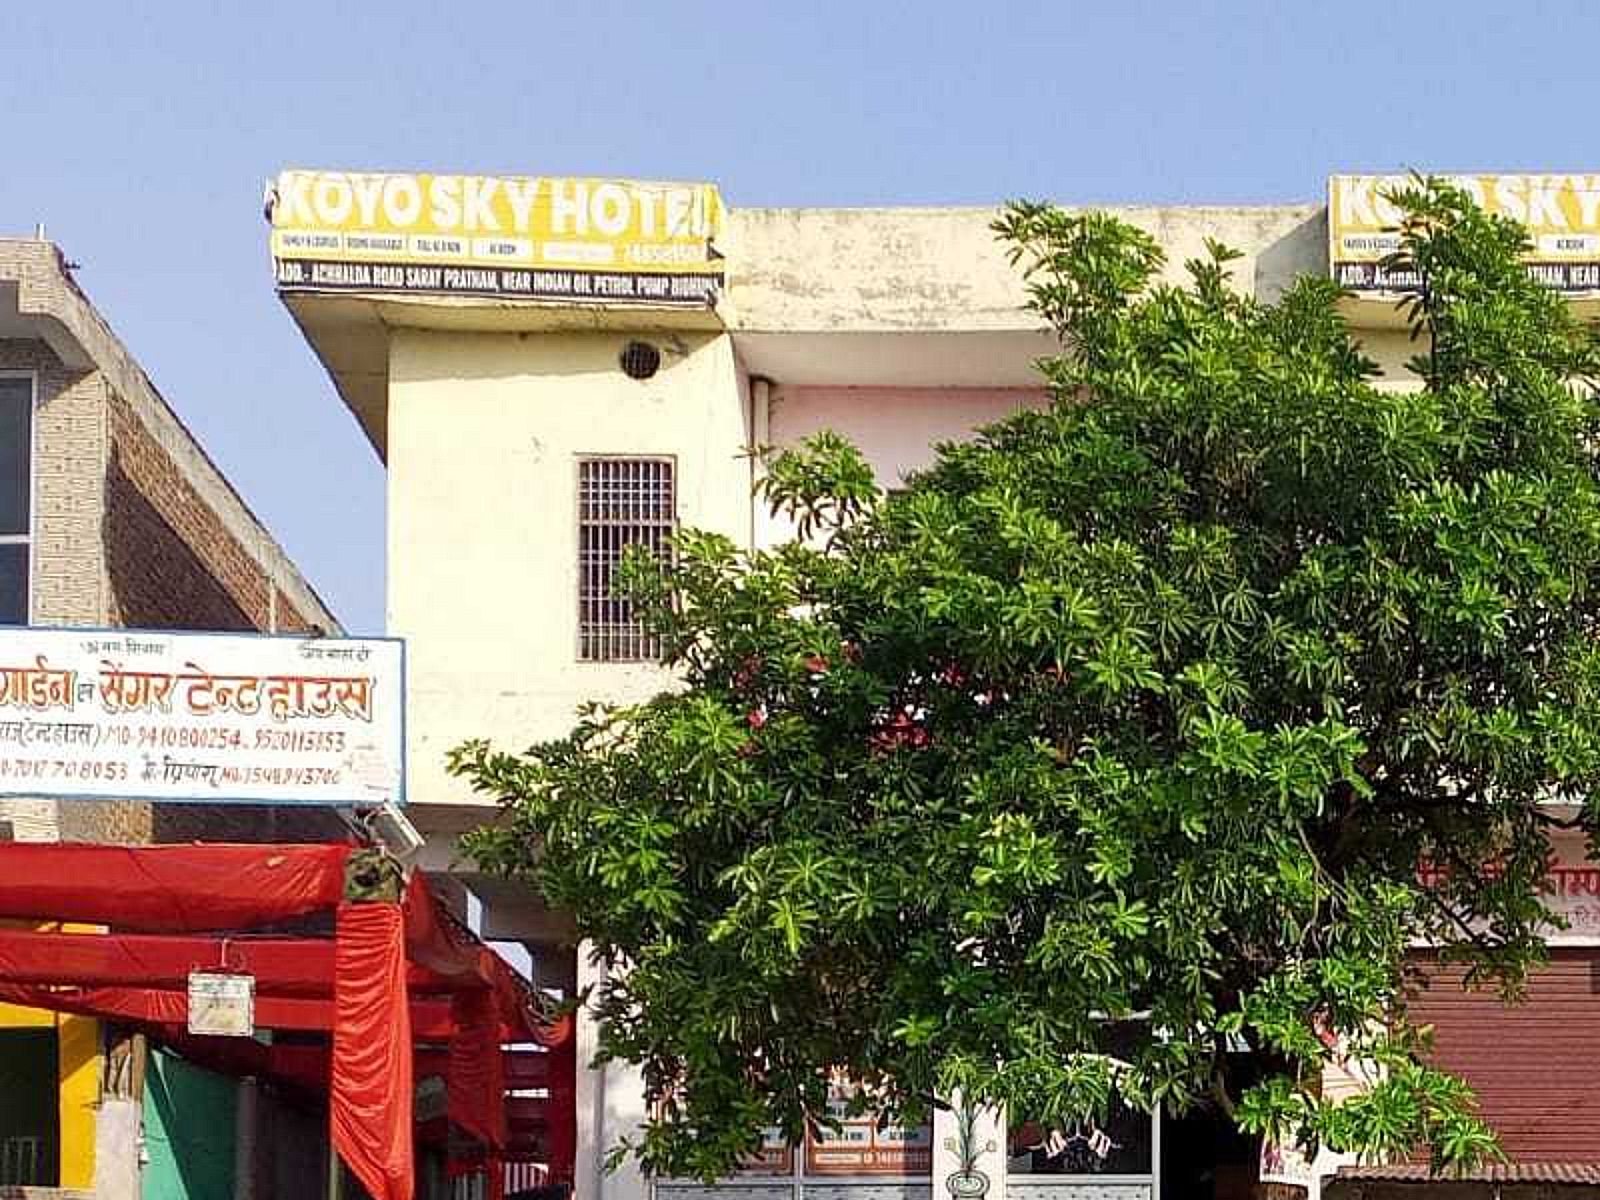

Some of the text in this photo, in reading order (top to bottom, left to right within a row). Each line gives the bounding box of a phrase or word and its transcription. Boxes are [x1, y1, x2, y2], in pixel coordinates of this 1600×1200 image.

[278, 171, 705, 239] KOYO SKY HOTEL
[1340, 176, 1486, 226] KO
